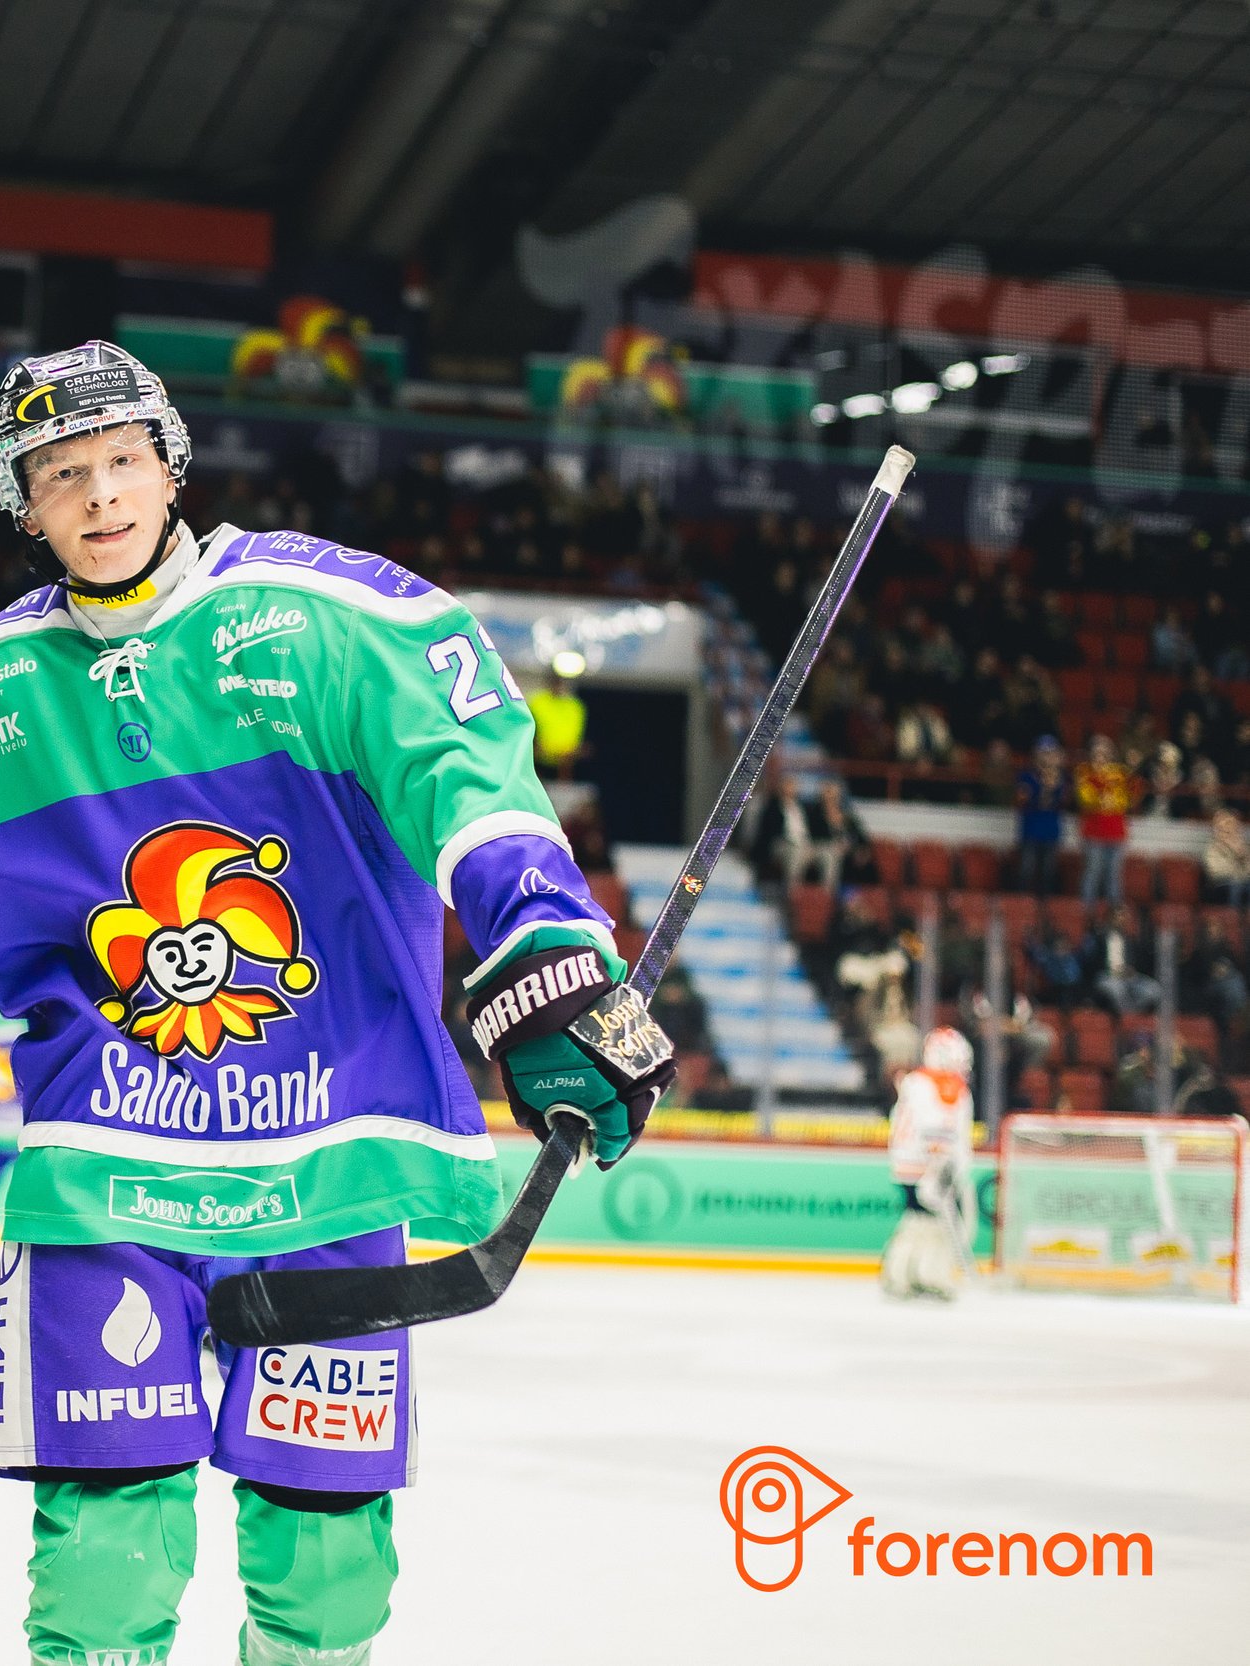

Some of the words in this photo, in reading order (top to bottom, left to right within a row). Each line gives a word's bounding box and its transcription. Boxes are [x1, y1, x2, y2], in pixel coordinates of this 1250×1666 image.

[64, 369, 128, 388] CREATIVE
[67, 379, 130, 395] TECHNOLOGY
[92, 396, 106, 405] Live
[106, 393, 126, 403] Events
[68, 413, 116, 431] GLASSDRIVE
[269, 538, 316, 554] link
[211, 605, 308, 655] Kukko
[270, 646, 292, 656] OLUT
[471, 950, 605, 1062] WARRIOR
[90, 1040, 211, 1134] Saldo
[217, 1050, 336, 1134] Bank
[533, 1076, 586, 1090] ALPHA
[258, 1346, 396, 1398] CABLE
[55, 1382, 199, 1423] INFUEL
[258, 1392, 388, 1443] CREW
